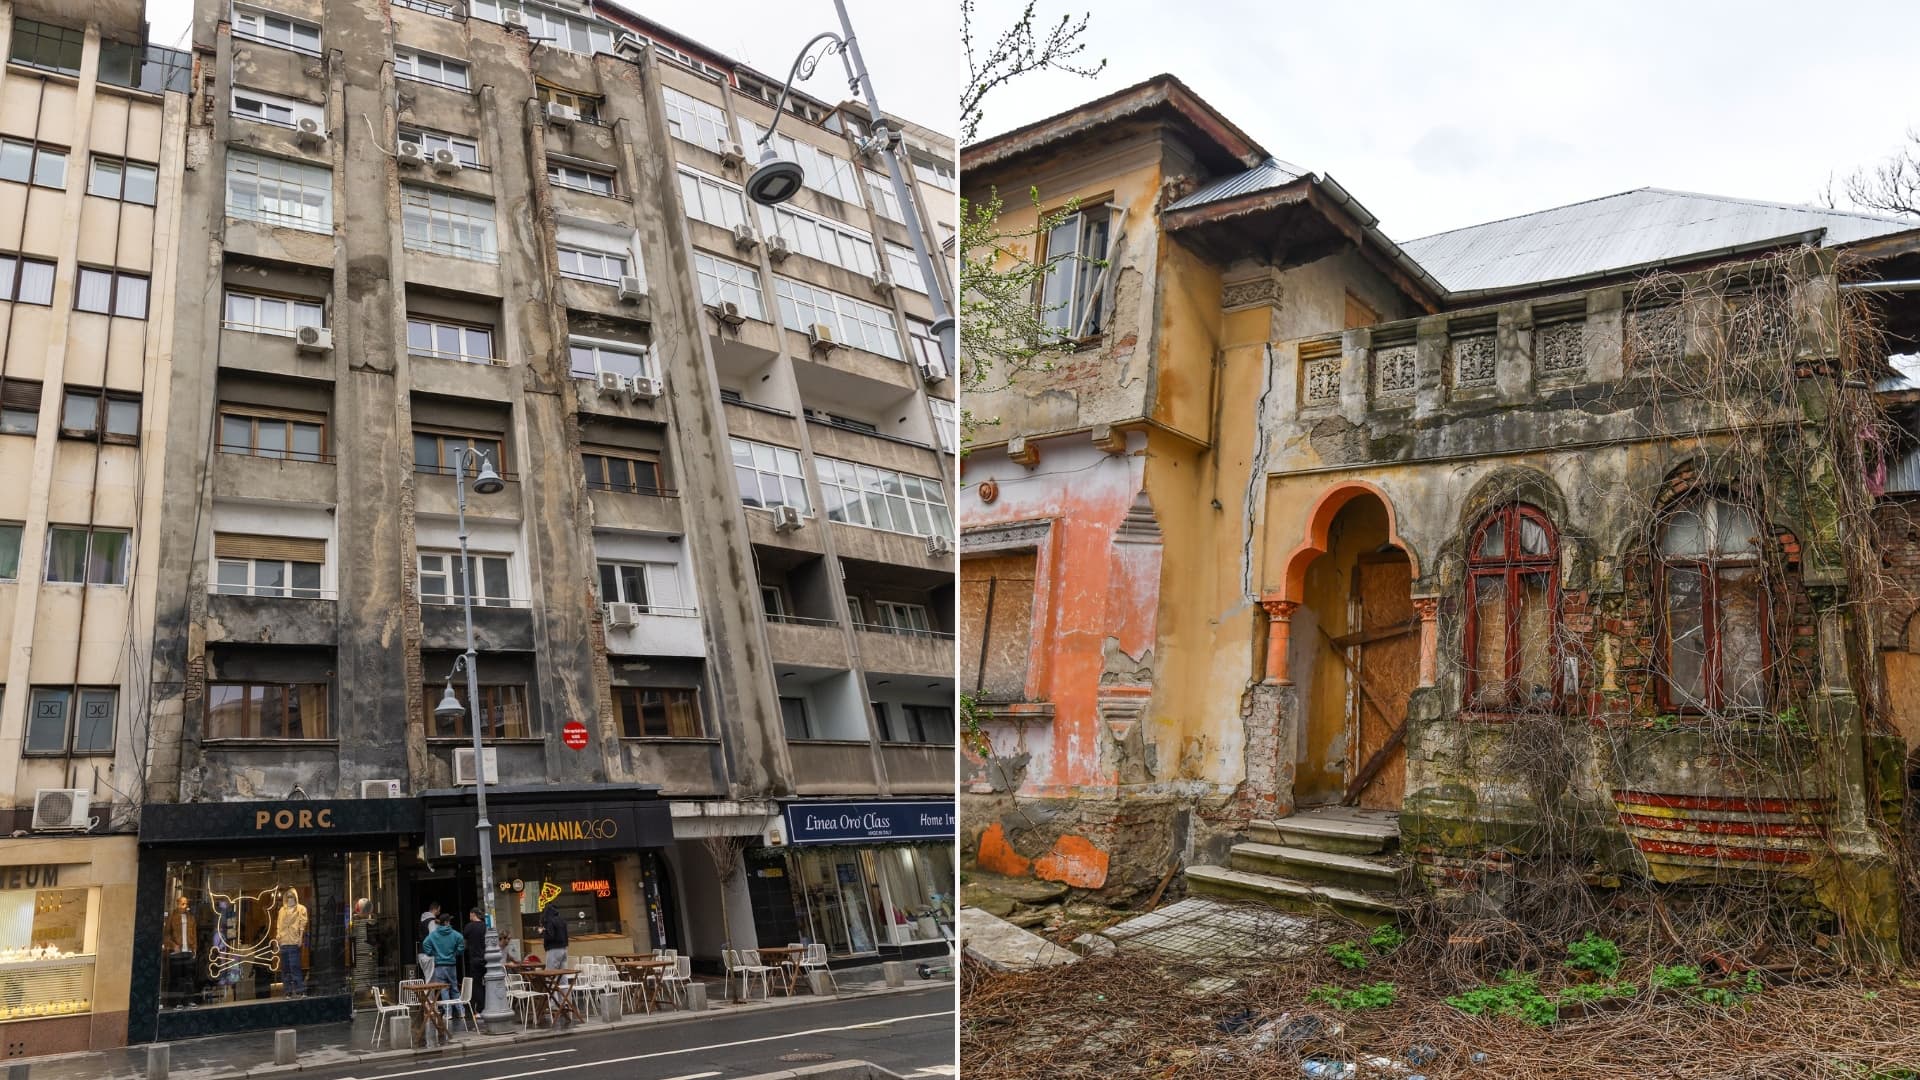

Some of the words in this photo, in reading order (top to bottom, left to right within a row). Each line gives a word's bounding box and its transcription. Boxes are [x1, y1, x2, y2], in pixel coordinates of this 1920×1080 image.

[498, 818, 618, 844] PIZZAMANIA2GO
[805, 814, 838, 831] Linea
[863, 812, 890, 830] Class
[920, 813, 943, 826] Home
[572, 880, 609, 892] PIZZAMANIA
